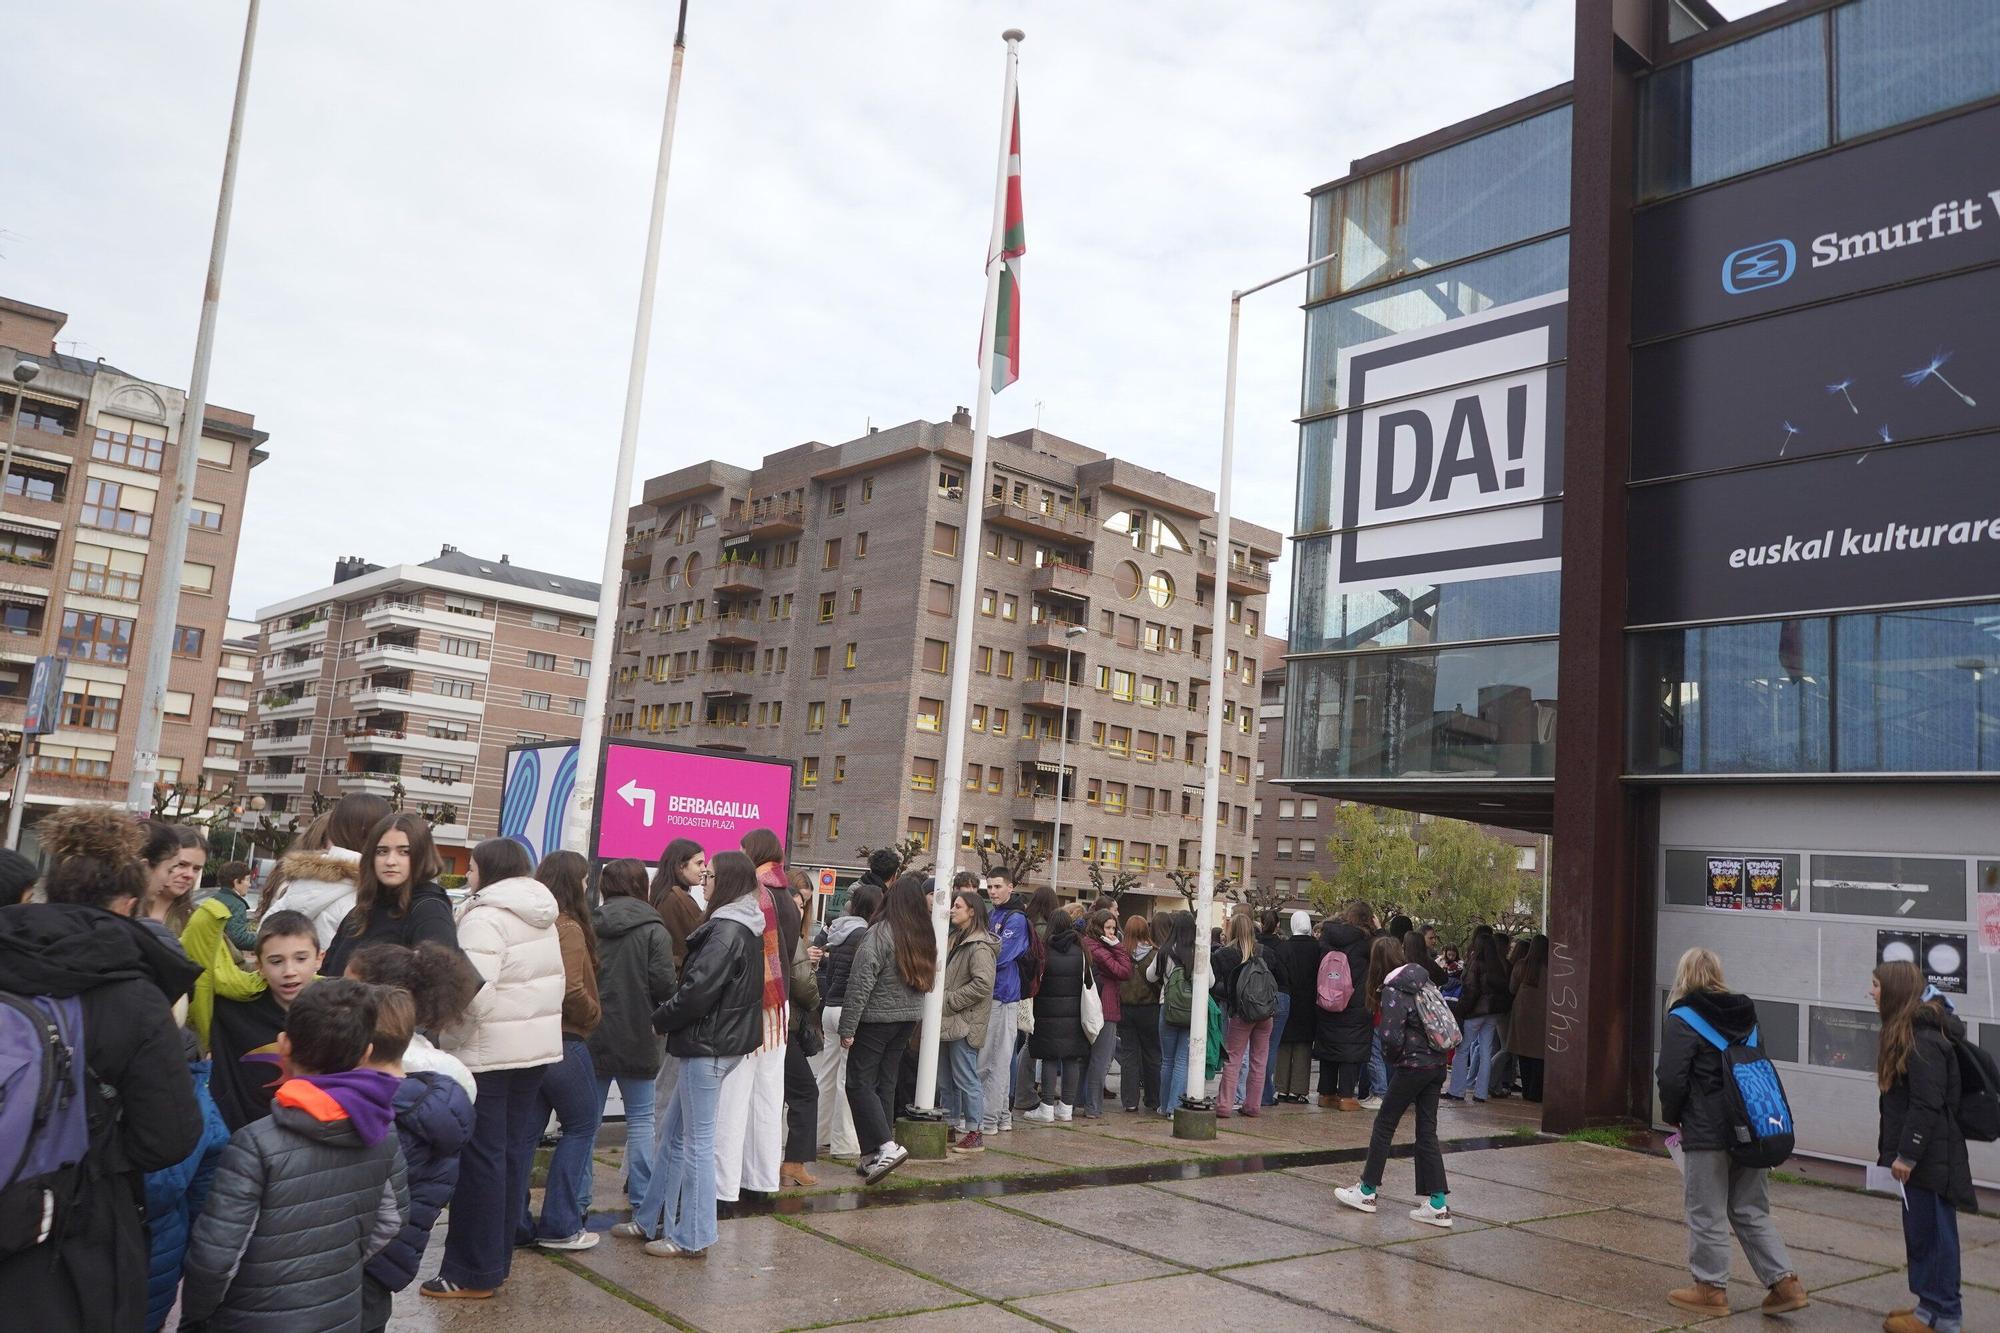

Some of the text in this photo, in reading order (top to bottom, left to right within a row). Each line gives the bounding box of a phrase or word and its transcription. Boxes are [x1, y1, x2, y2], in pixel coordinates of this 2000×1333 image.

[1811, 199, 1982, 268] Smurfit
[1375, 384, 1527, 511] DA!
[1729, 530, 1834, 568] euskal
[33, 662, 46, 697] P
[667, 815, 735, 830] PODCASTEN PLAZA
[669, 796, 760, 820] BERBAGAILUA
